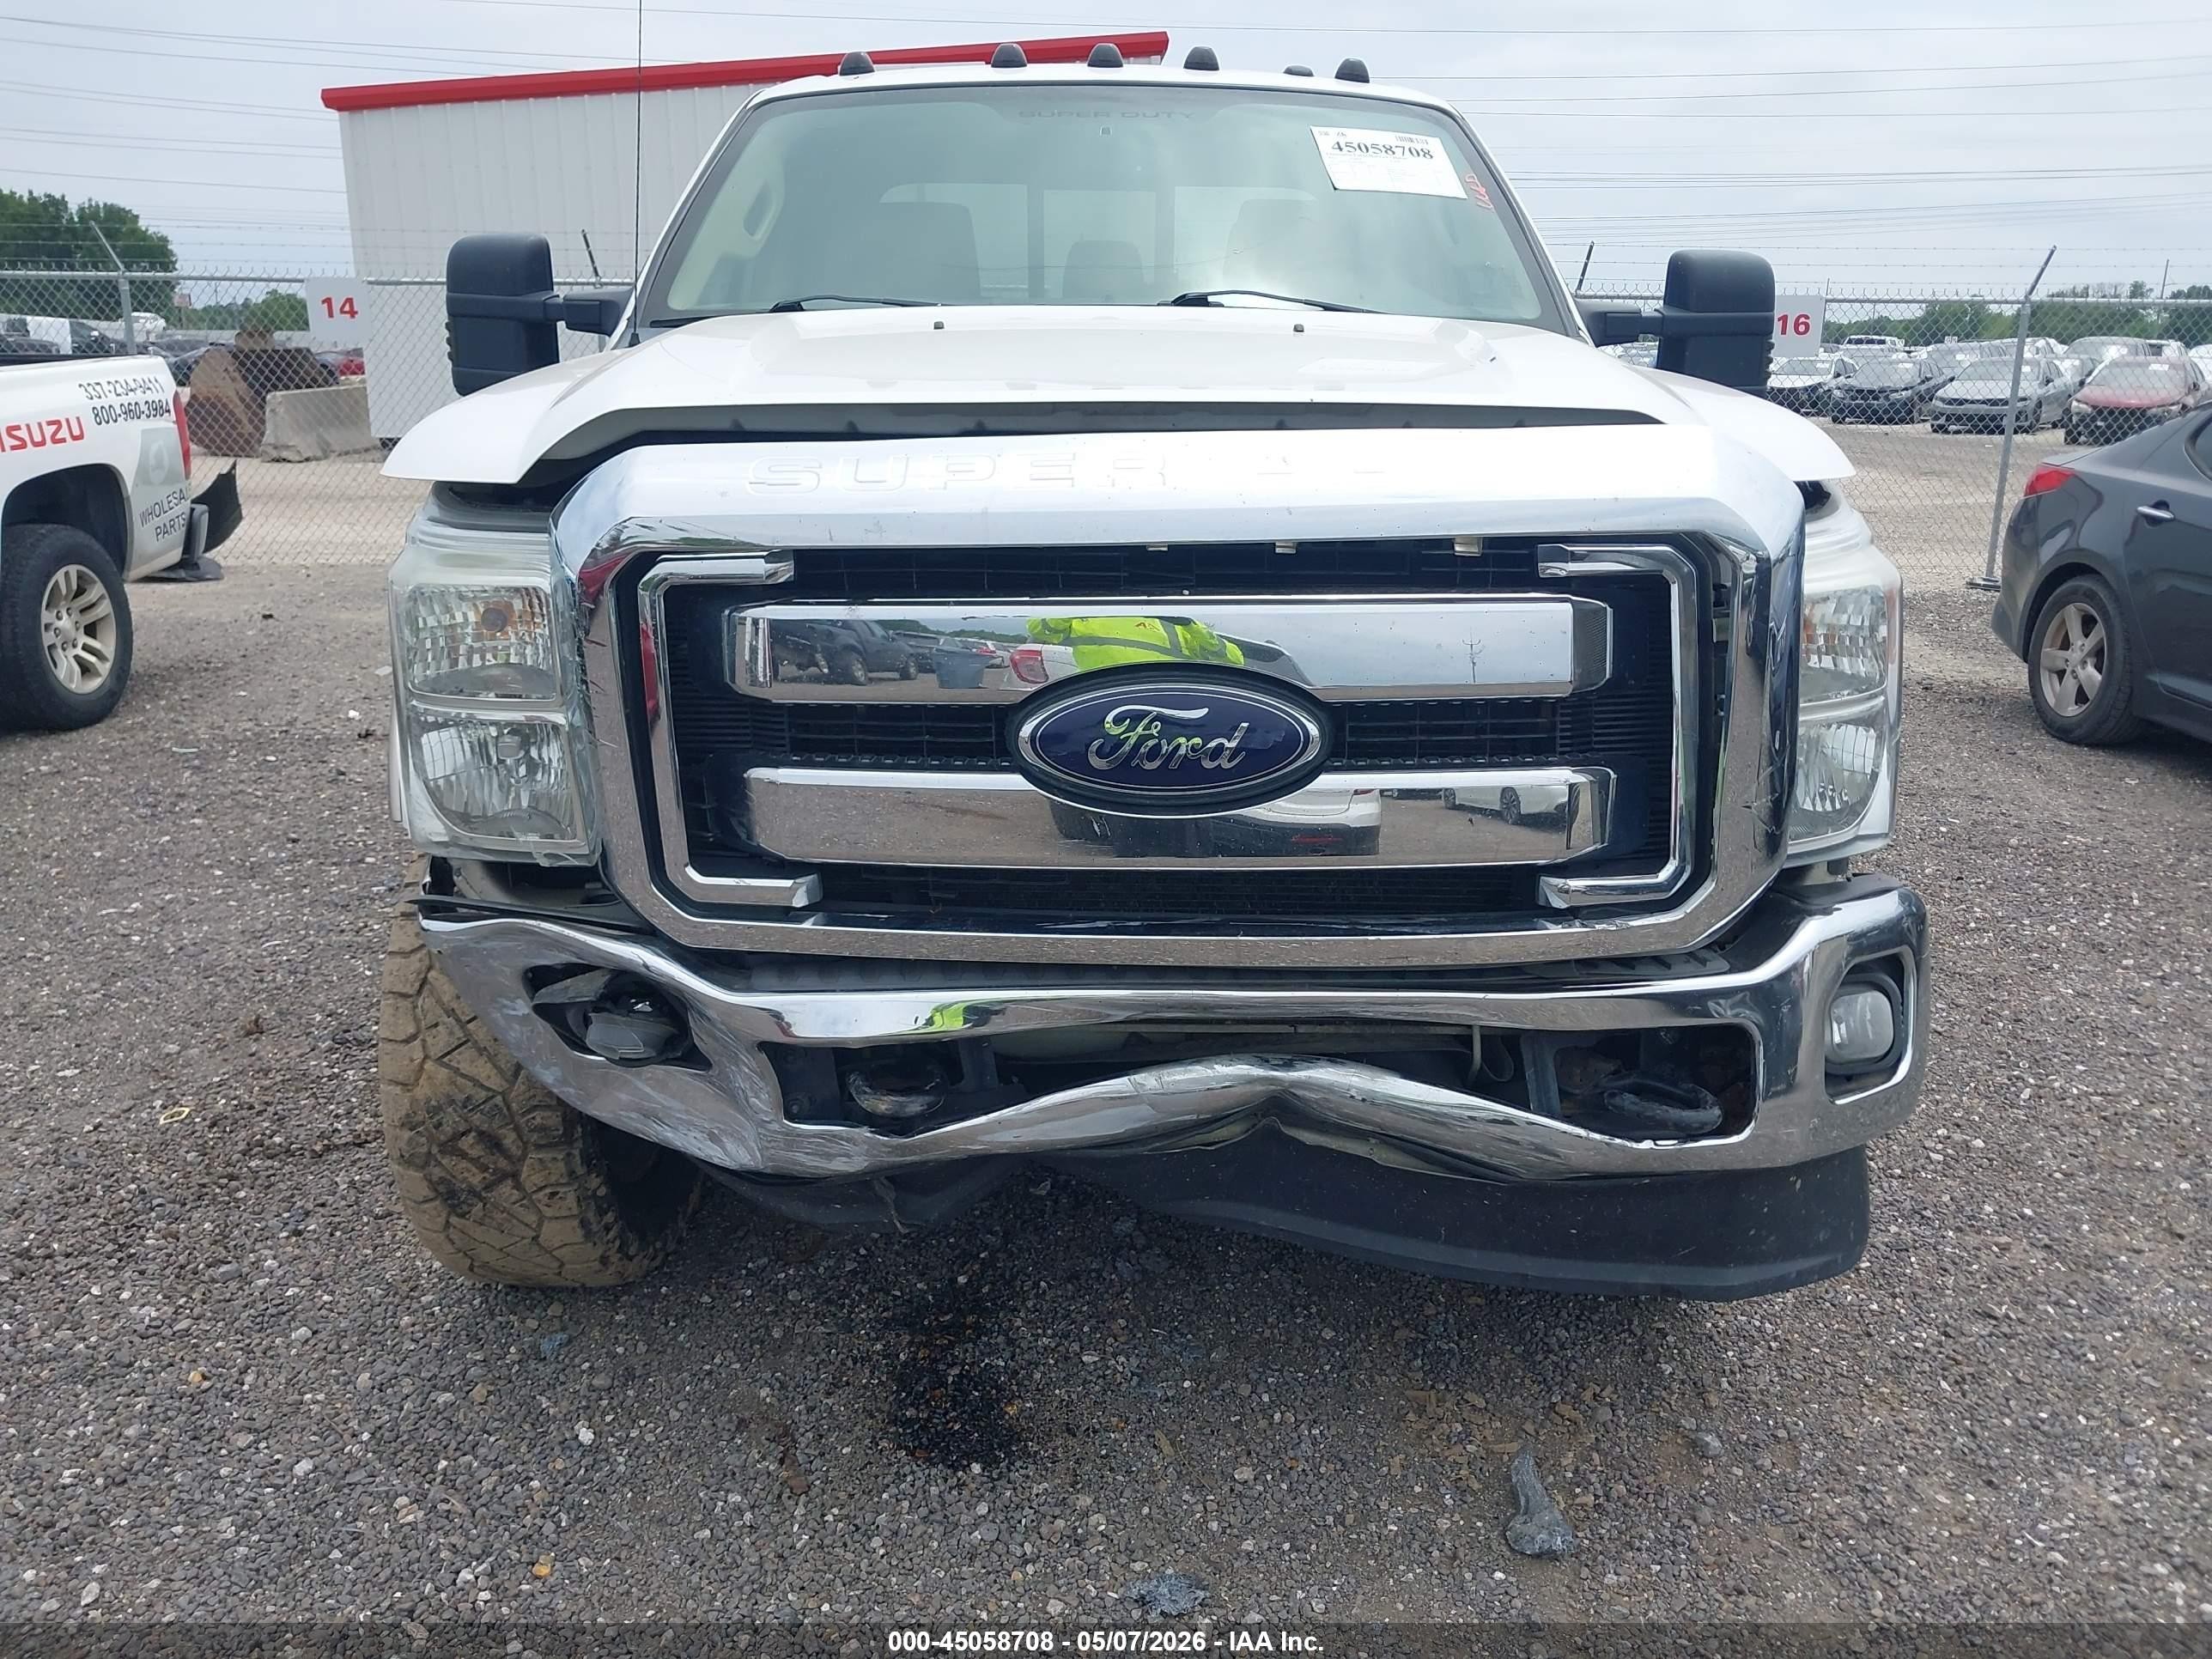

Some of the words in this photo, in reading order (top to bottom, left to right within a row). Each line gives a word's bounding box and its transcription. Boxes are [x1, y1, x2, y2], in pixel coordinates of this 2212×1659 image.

[1018, 110, 1110, 119] SUPER
[1120, 110, 1195, 119] DUTY
[1331, 141, 1434, 160] 45058708
[320, 296, 359, 319] 14
[1777, 313, 1811, 336] 16
[78, 375, 165, 400] 337-234-9411
[91, 398, 171, 426] 800-960-3984
[0, 416, 85, 453] ISUZU
[746, 451, 1168, 496] SUPER
[155, 512, 186, 543] PARTS
[1086, 704, 1250, 769] Ford
